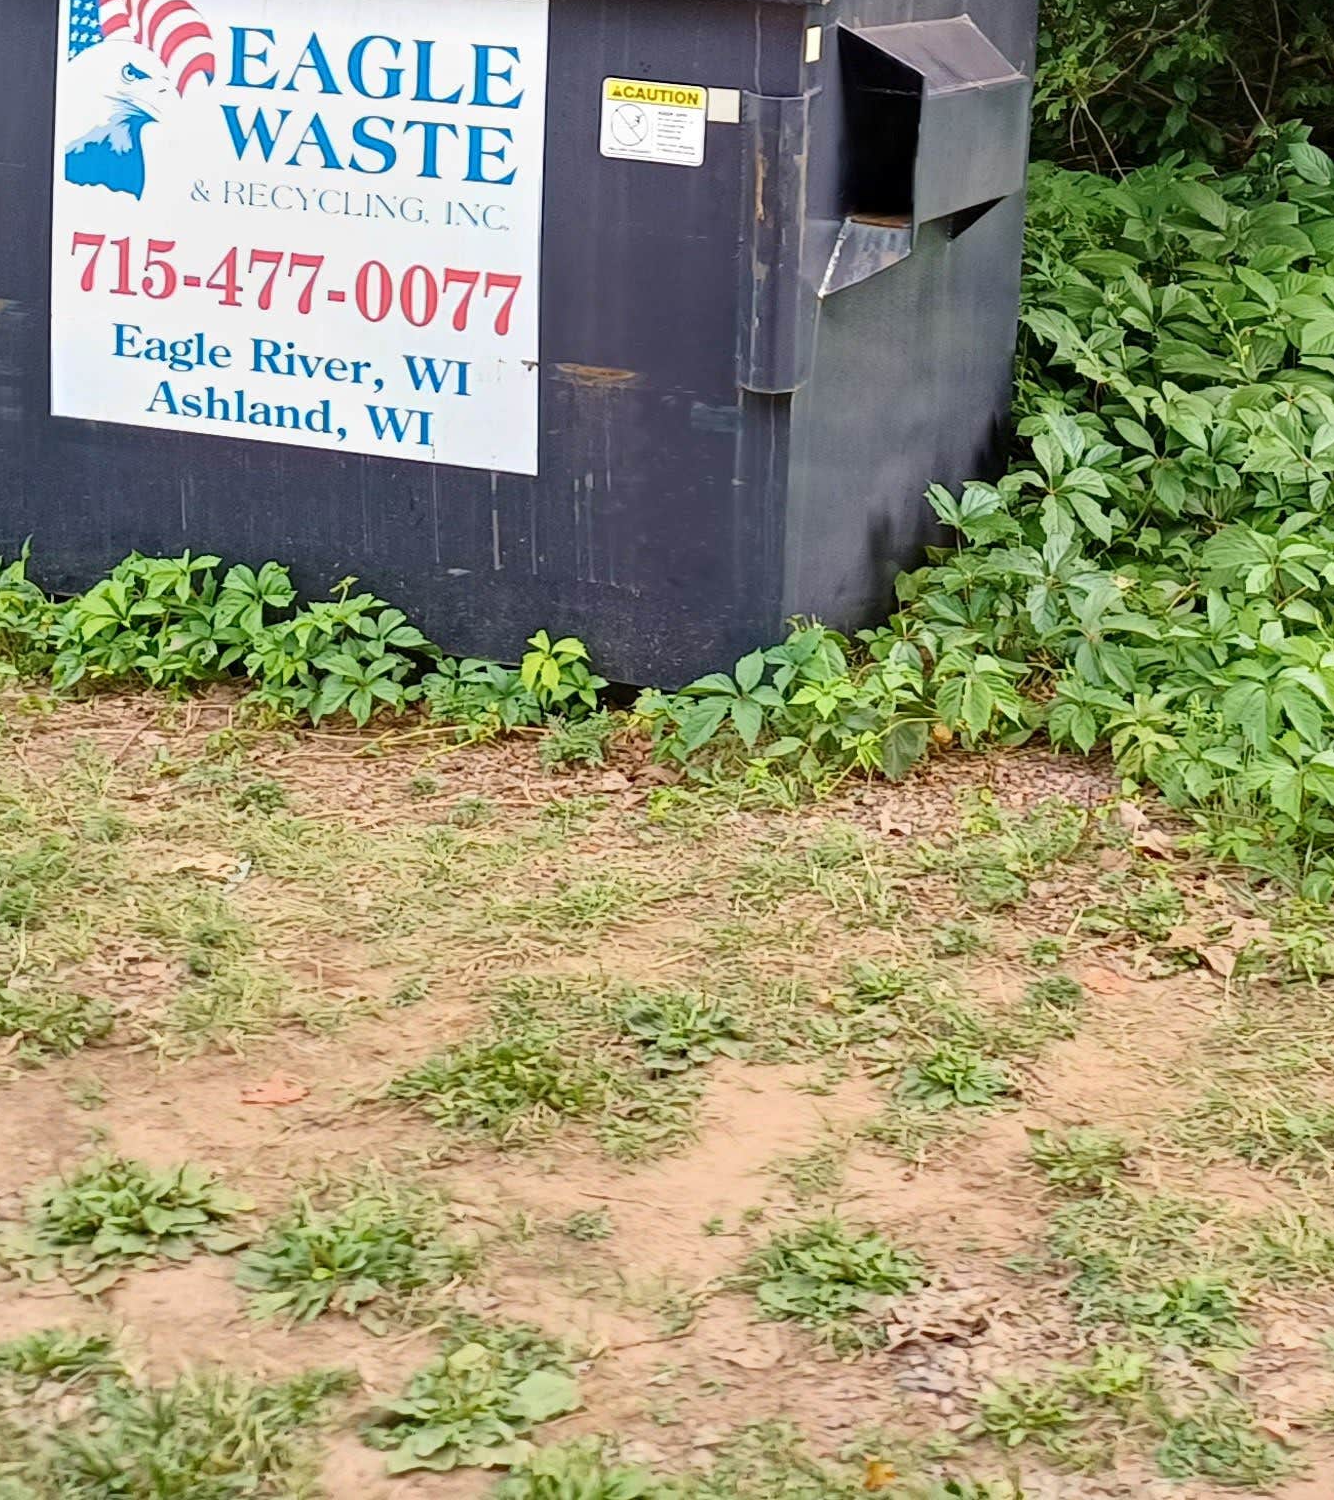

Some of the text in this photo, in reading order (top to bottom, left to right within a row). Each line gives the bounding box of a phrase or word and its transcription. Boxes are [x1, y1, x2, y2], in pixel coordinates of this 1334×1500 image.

[225, 26, 526, 109] EAGLE
[623, 85, 699, 105] CAUTION
[220, 105, 519, 185] WASTE
[190, 180, 211, 202] &
[70, 232, 523, 336] 715-477-0077
[111, 323, 473, 397] Eagle River, WI
[146, 381, 435, 446] Ashland, WI
